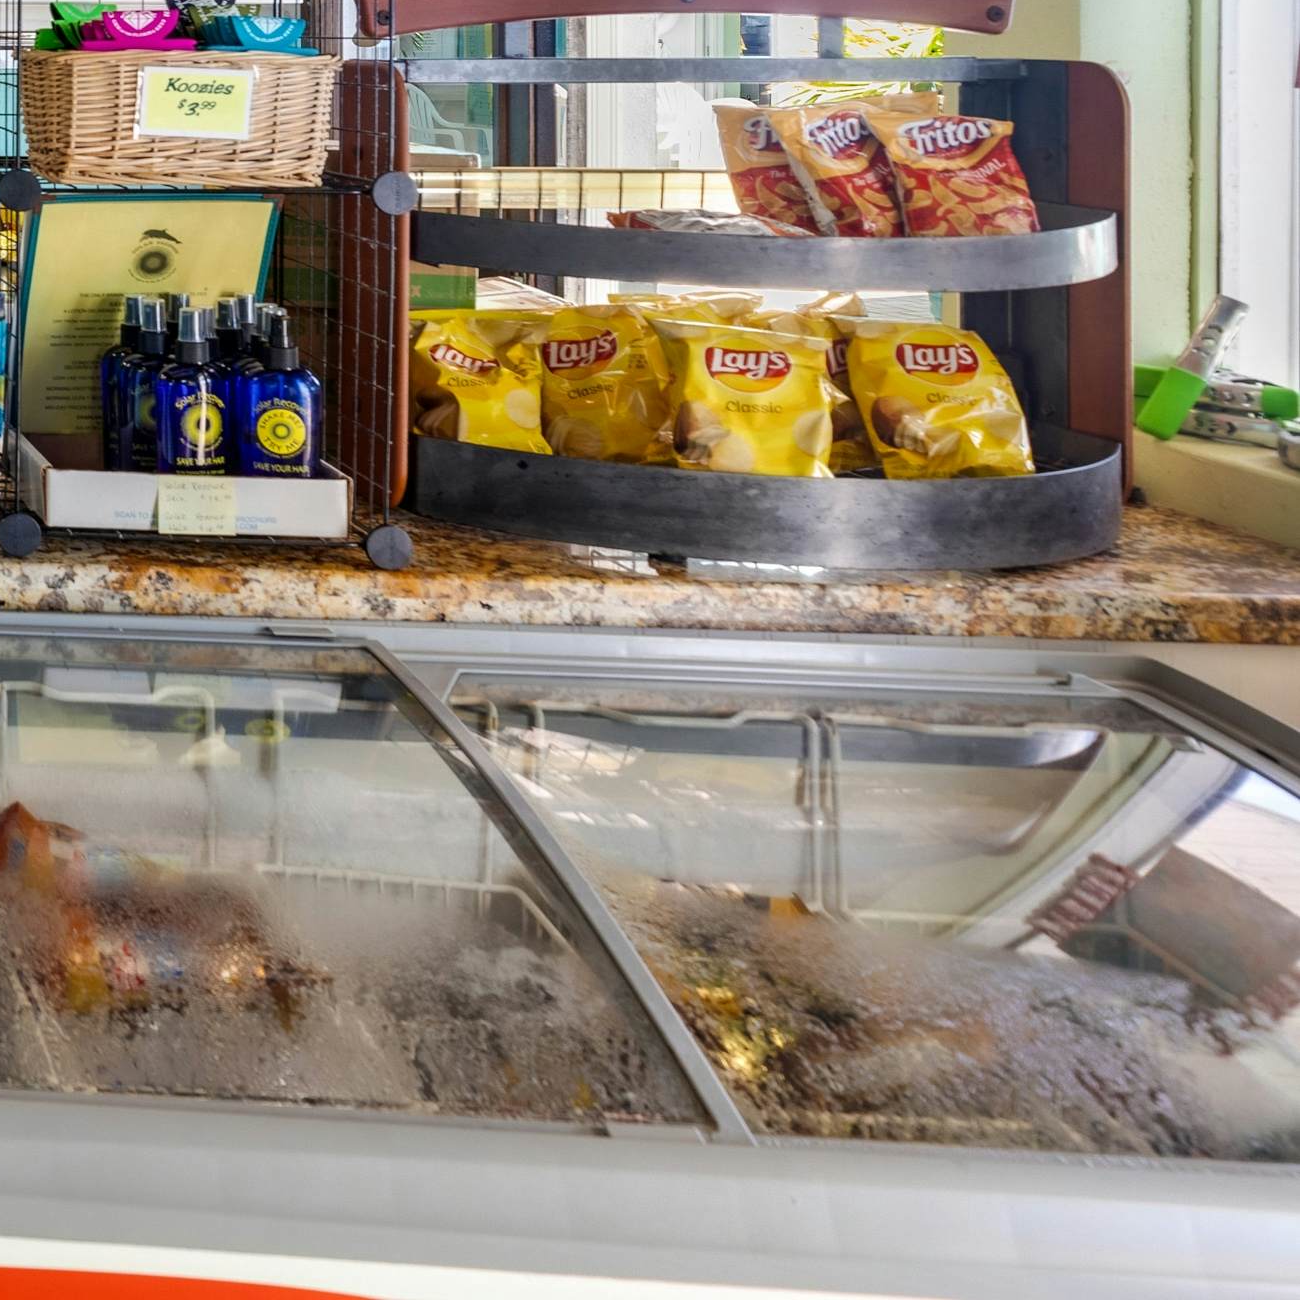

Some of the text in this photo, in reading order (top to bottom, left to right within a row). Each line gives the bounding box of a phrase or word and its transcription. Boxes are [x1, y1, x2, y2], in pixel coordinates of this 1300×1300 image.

[165, 78, 234, 95] Koozies
[898, 120, 992, 156] Fritos
[549, 334, 616, 368] Lay's
[711, 348, 786, 380] Lay's
[903, 343, 975, 374] Lay's
[726, 401, 783, 413] Classic
